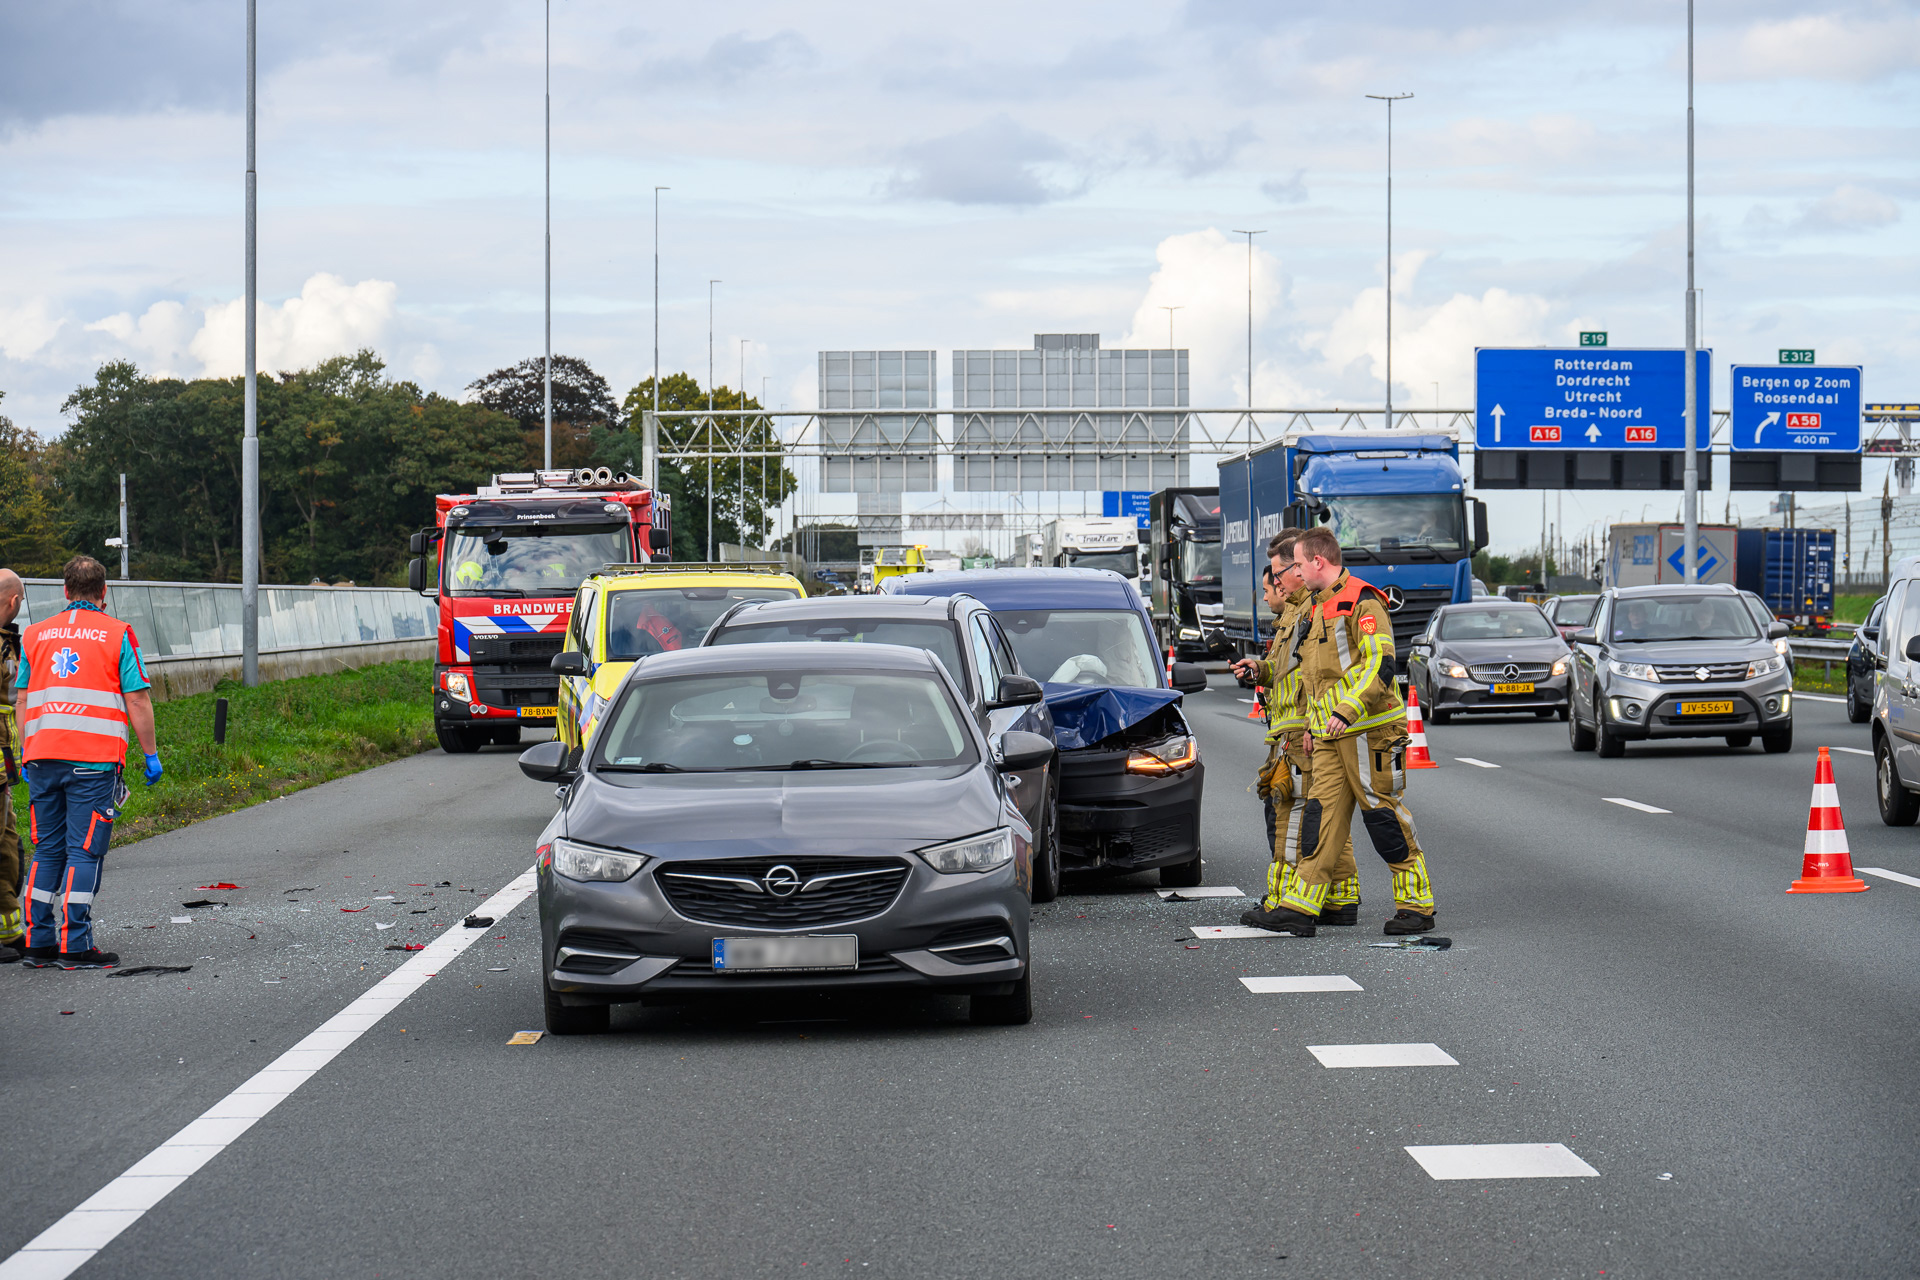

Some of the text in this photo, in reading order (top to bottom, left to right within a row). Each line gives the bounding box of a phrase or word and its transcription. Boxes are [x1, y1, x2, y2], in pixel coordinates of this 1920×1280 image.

[1554, 358, 1633, 371] Rotterdam
[1556, 374, 1631, 387] Dordrecht
[1742, 375, 1851, 391] Bergen op Zoom
[1564, 390, 1622, 403] Utrecht
[1754, 391, 1839, 404] Roosendaal
[1793, 435, 1830, 445] 400 m
[493, 603, 573, 615] BRANDWEE
[37, 627, 108, 642] AMBULANCE
[1496, 683, 1531, 692] N-881-JX
[1685, 702, 1730, 713] JV-556-V
[715, 956, 724, 964] PL
